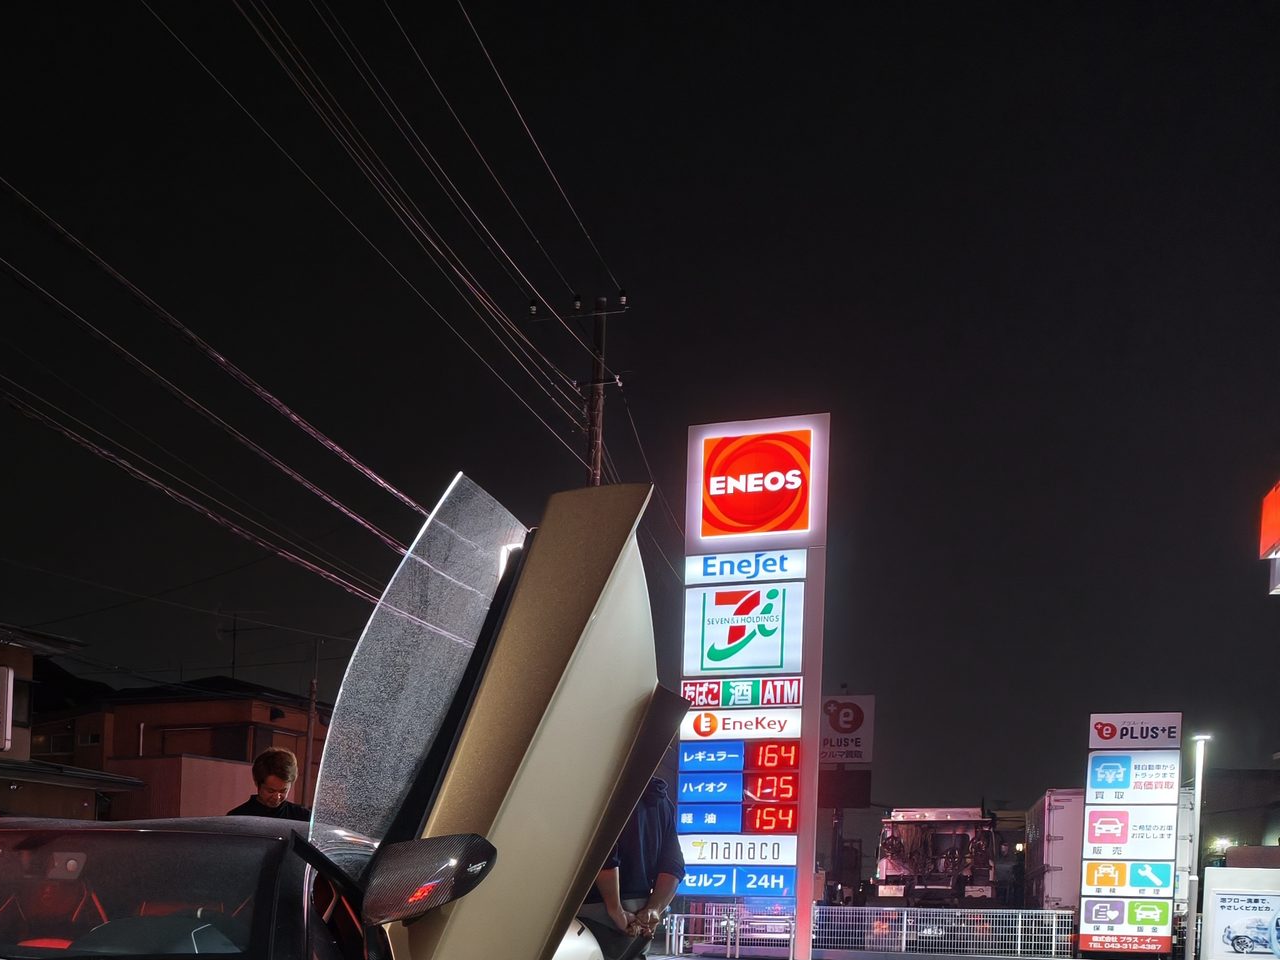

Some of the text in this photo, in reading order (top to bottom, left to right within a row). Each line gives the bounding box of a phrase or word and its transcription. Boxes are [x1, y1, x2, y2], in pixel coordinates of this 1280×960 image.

[709, 469, 802, 496] ENEOS
[740, 614, 780, 624] HOLDINGS
[684, 680, 799, 706] たばこ 酒 ATM
[721, 716, 788, 732] EneKey
[683, 744, 796, 767] レギュラー 164
[682, 776, 793, 798] ハイオク 175
[1132, 780, 1175, 790] 高価買取
[755, 807, 793, 830] 154
[710, 842, 780, 860] nanaco
[683, 873, 785, 889] セルフ 24H
